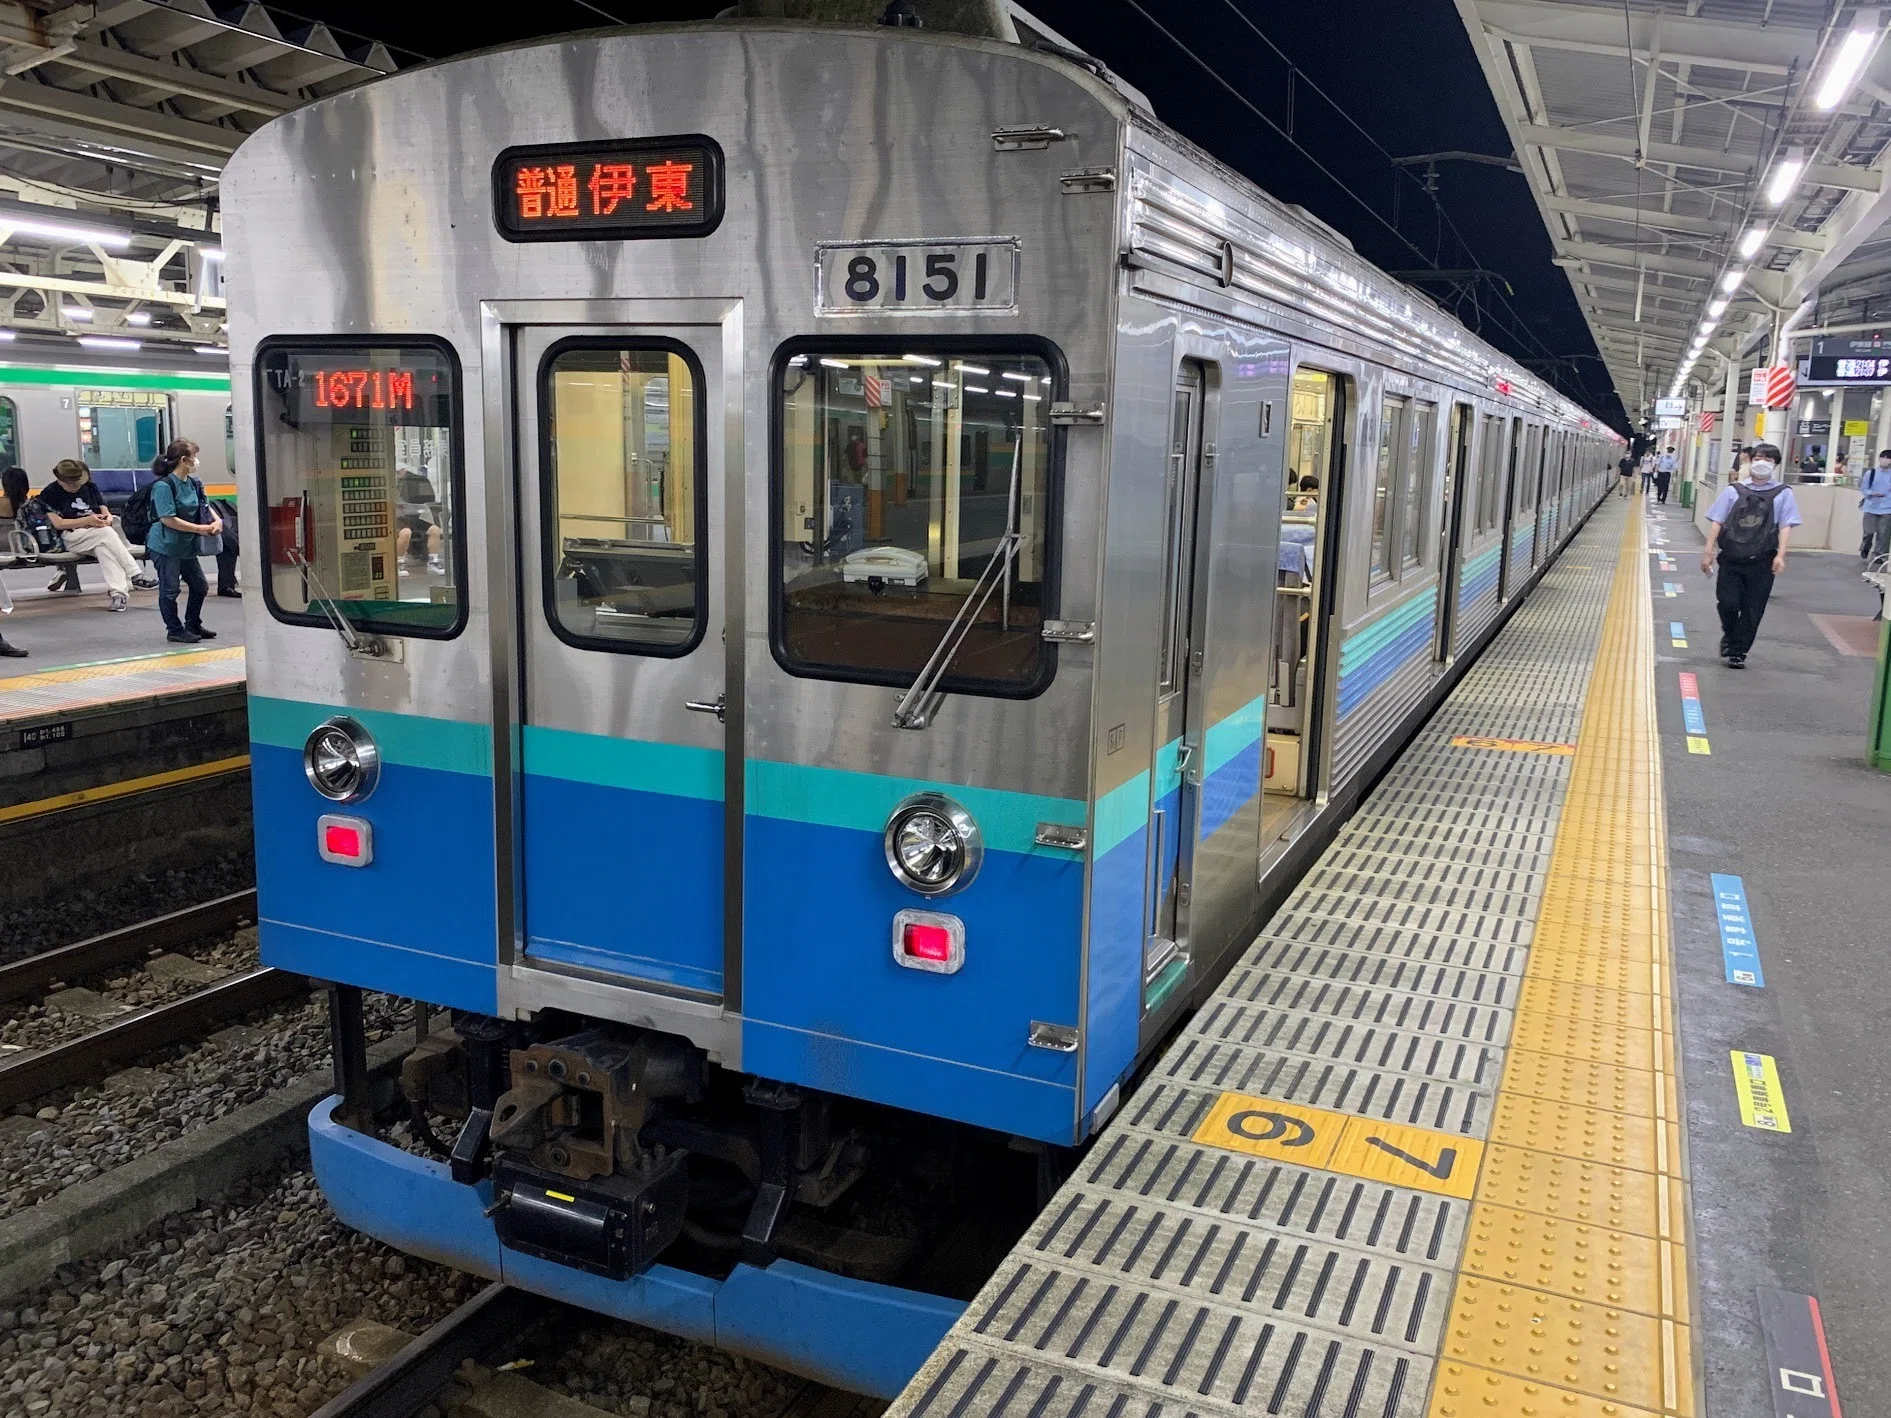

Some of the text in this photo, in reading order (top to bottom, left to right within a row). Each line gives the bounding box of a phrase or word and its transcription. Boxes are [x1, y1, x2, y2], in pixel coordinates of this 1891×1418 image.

[517, 160, 693, 217] 普通 伊東
[845, 253, 987, 301] 8151
[62, 398, 70, 409] 7
[316, 371, 412, 409] 1671M
[1227, 1110, 1315, 1147] 6
[1365, 1136, 1457, 1180] 7
